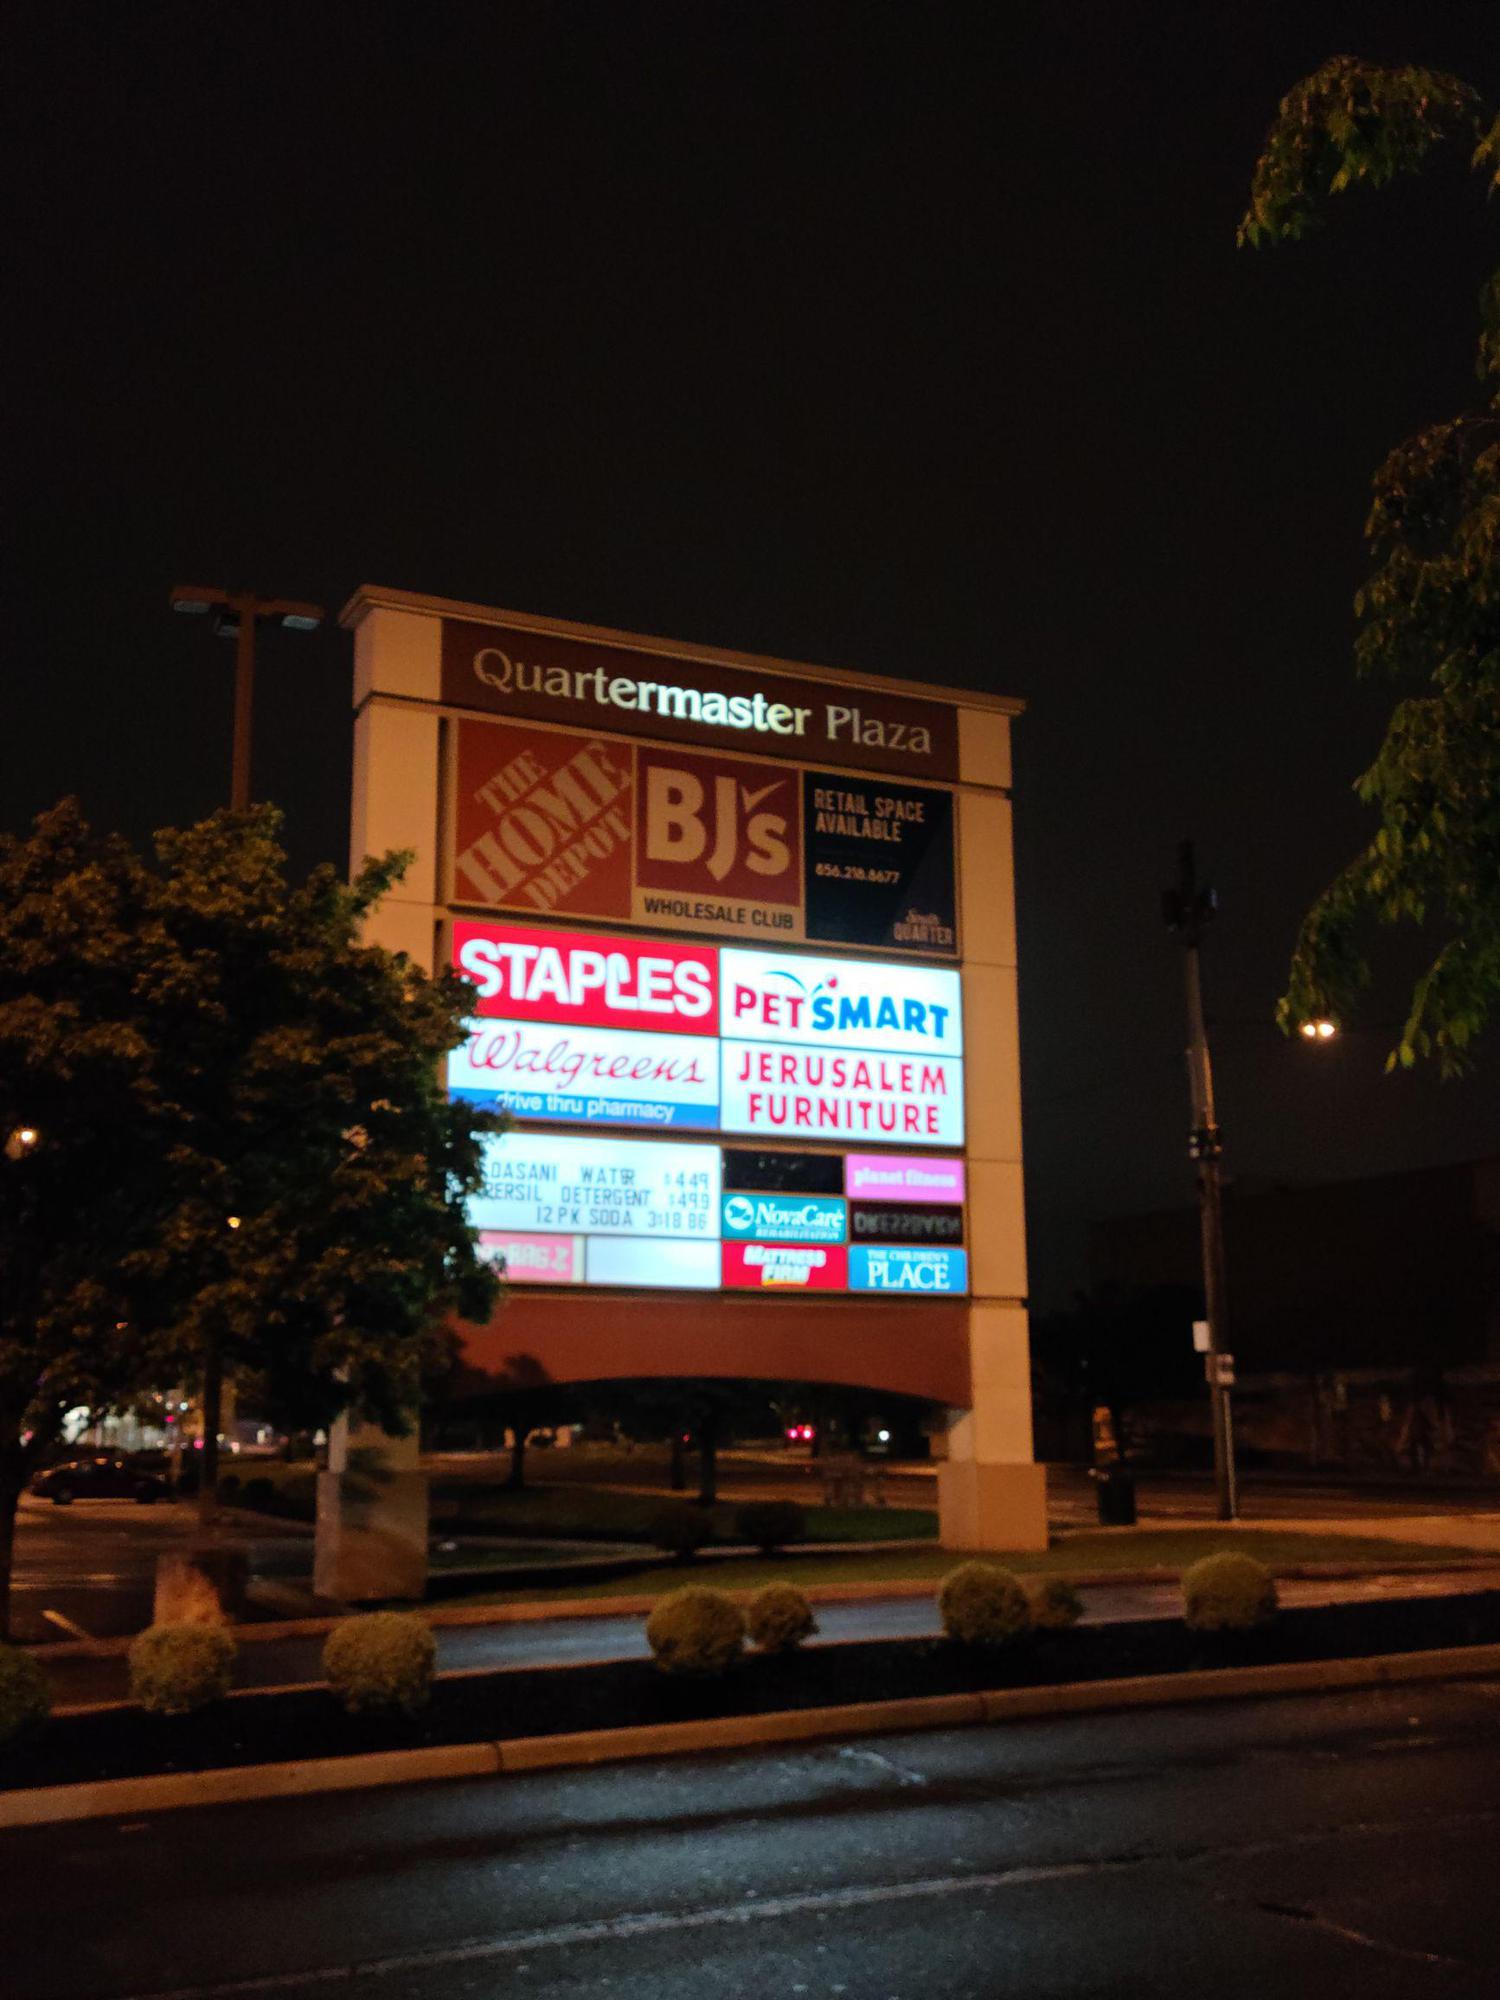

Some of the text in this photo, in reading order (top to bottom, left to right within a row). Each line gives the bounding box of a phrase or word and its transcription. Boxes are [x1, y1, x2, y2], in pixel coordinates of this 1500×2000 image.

[473, 648, 931, 754] Quartermaster Plaza
[473, 749, 548, 814] THE
[455, 740, 632, 904] HOME
[814, 788, 925, 823] RETAIL SPACE
[815, 811, 902, 842] AVAILABLE
[522, 805, 632, 912] DEPOT
[644, 896, 794, 929] WHOLESALE CLUB
[460, 938, 712, 1017] STAPLES
[468, 1030, 705, 1090] Walgreens
[739, 1051, 947, 1095] JERUSALEM
[546, 1093, 583, 1113] thru
[587, 1098, 675, 1124] pharmacy
[749, 1093, 939, 1135] FURNITURE
[491, 1161, 558, 1182] DASANI
[561, 1186, 652, 1207] DETERGENT
[589, 1208, 633, 1226] SODA
[755, 1202, 845, 1227] NovaCare
[867, 1260, 951, 1290] PLACE
